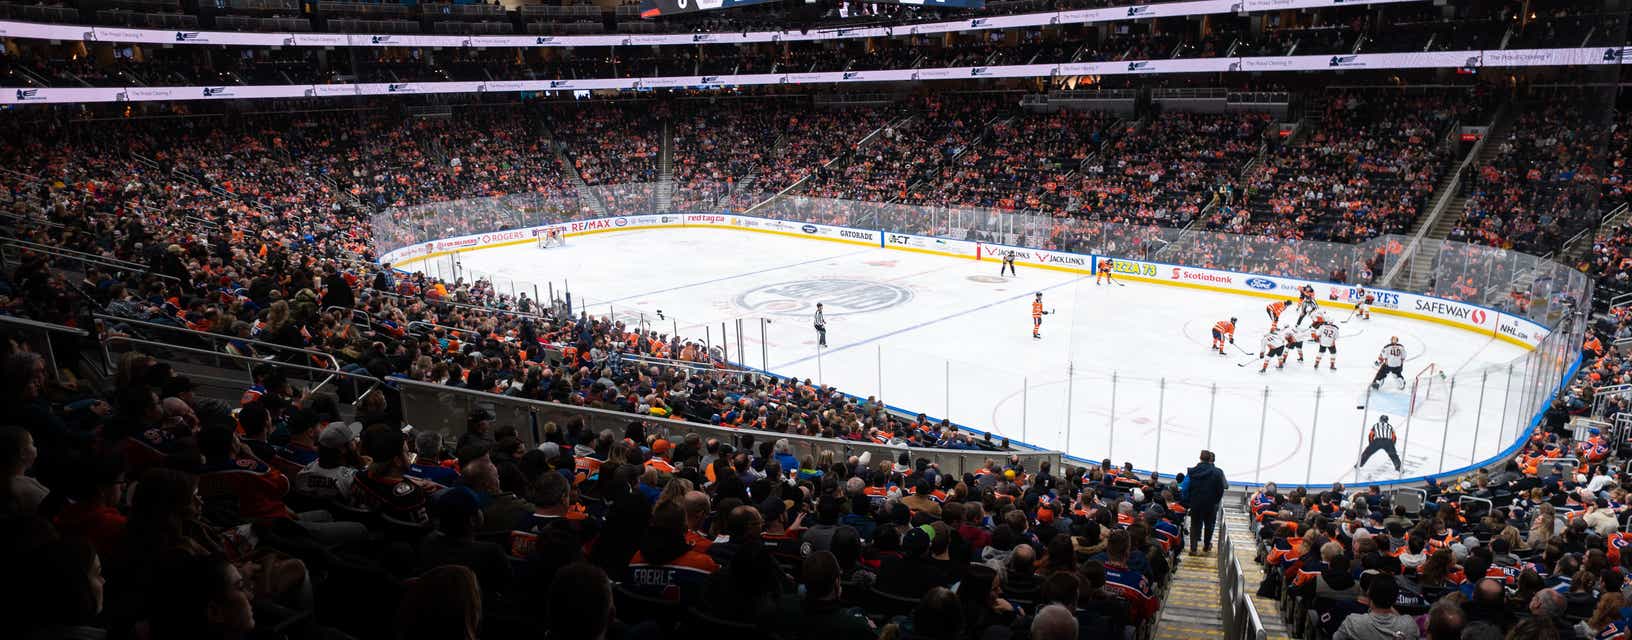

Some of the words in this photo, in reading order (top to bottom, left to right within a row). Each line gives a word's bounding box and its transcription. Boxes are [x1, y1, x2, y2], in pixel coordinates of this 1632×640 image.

[571, 218, 611, 233] RE/MAX
[491, 231, 524, 242] ROGERS
[839, 229, 873, 241] GATORADE
[1049, 255, 1065, 264] JACK
[1113, 261, 1141, 275] IZZA
[1143, 264, 1157, 277] 73
[1183, 271, 1232, 284] Scotiabank
[1250, 279, 1272, 290] Ford
[1349, 288, 1399, 305] PYE'S
[1415, 299, 1472, 320] SAFEWAY
[1323, 328, 1334, 338] 42
[633, 568, 676, 585] EBERLE
